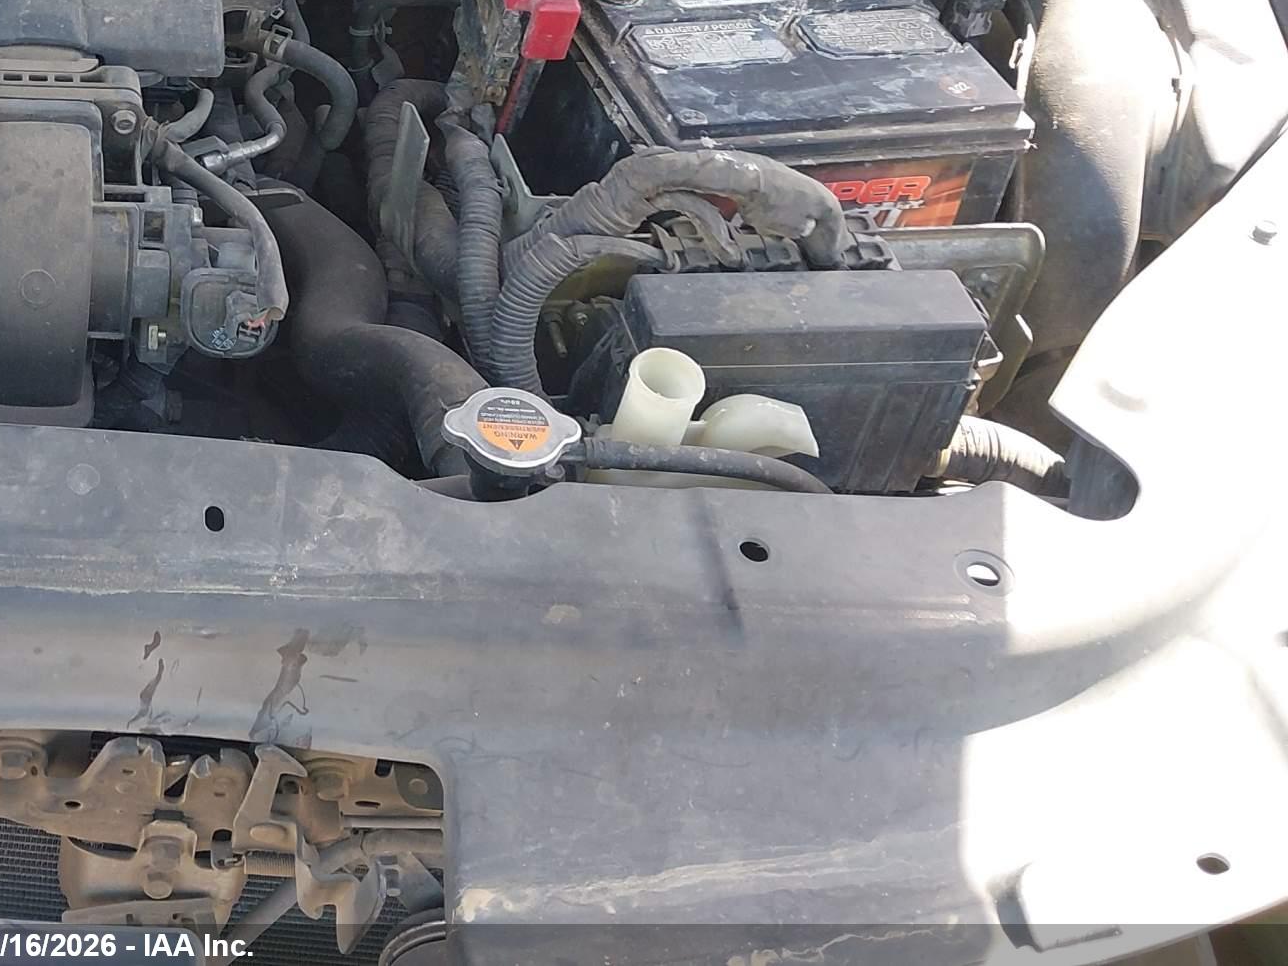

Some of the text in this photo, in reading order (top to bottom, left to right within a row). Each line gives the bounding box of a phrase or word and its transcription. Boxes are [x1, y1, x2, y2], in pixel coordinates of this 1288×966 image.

[655, 24, 701, 34] DANGER
[711, 22, 754, 31] POISON
[824, 175, 932, 204] PER
[494, 432, 538, 440] WARNING
